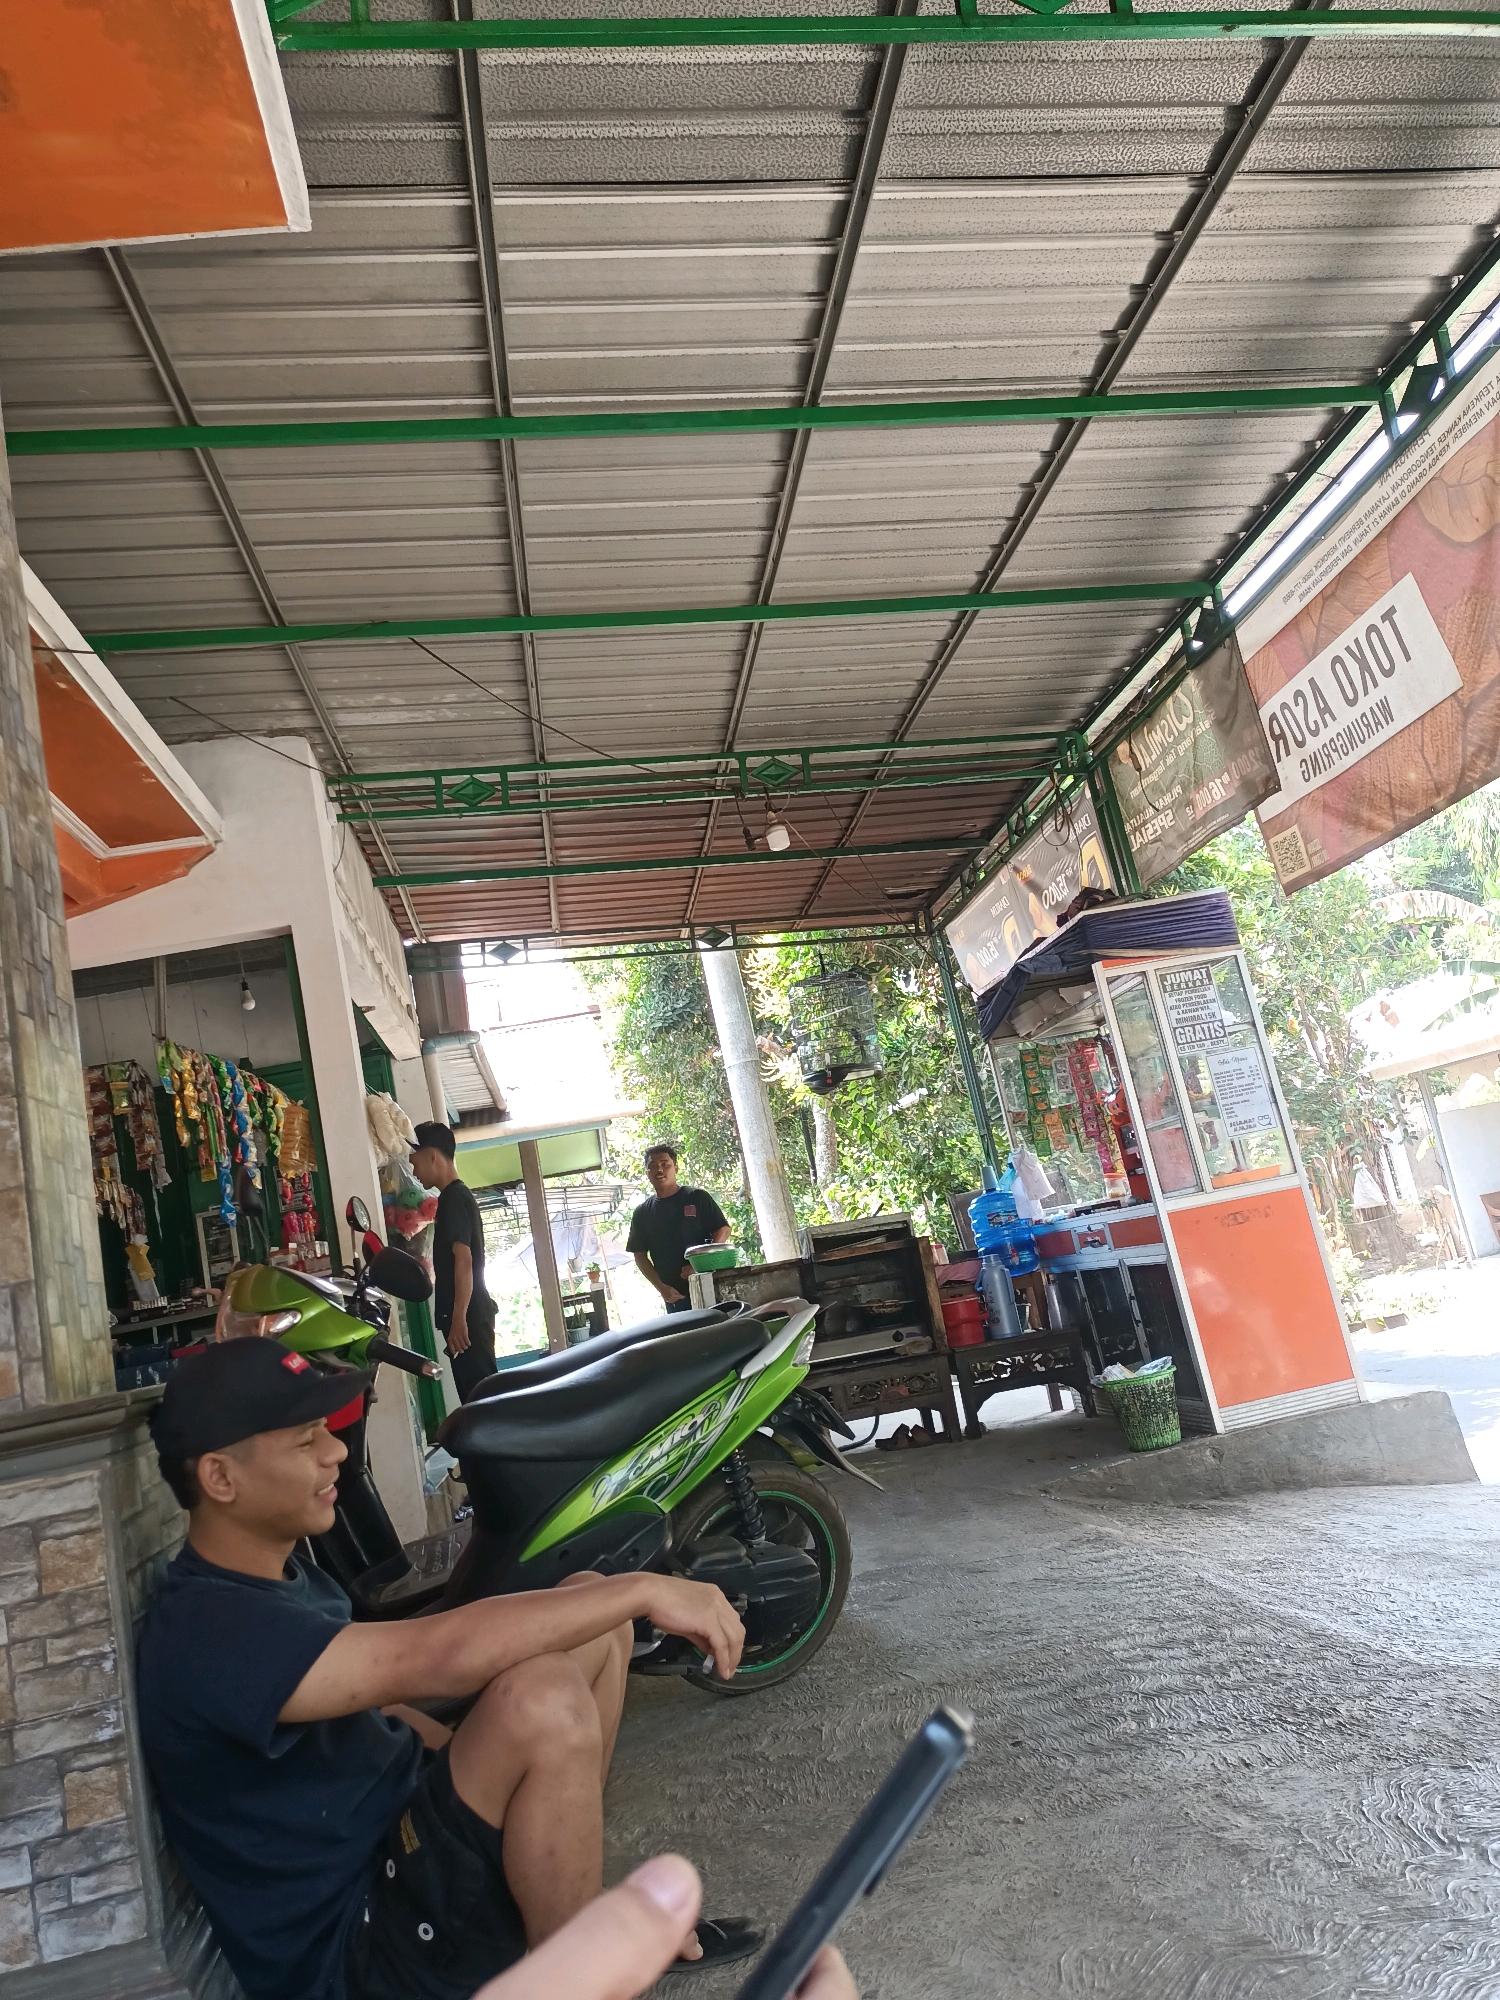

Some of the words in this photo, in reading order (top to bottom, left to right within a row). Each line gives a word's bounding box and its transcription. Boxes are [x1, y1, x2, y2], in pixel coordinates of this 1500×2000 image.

[1163, 968, 1208, 985] JUMAT
[1166, 979, 1210, 991] BERKAH
[1176, 1021, 1224, 1043] GRATIS
